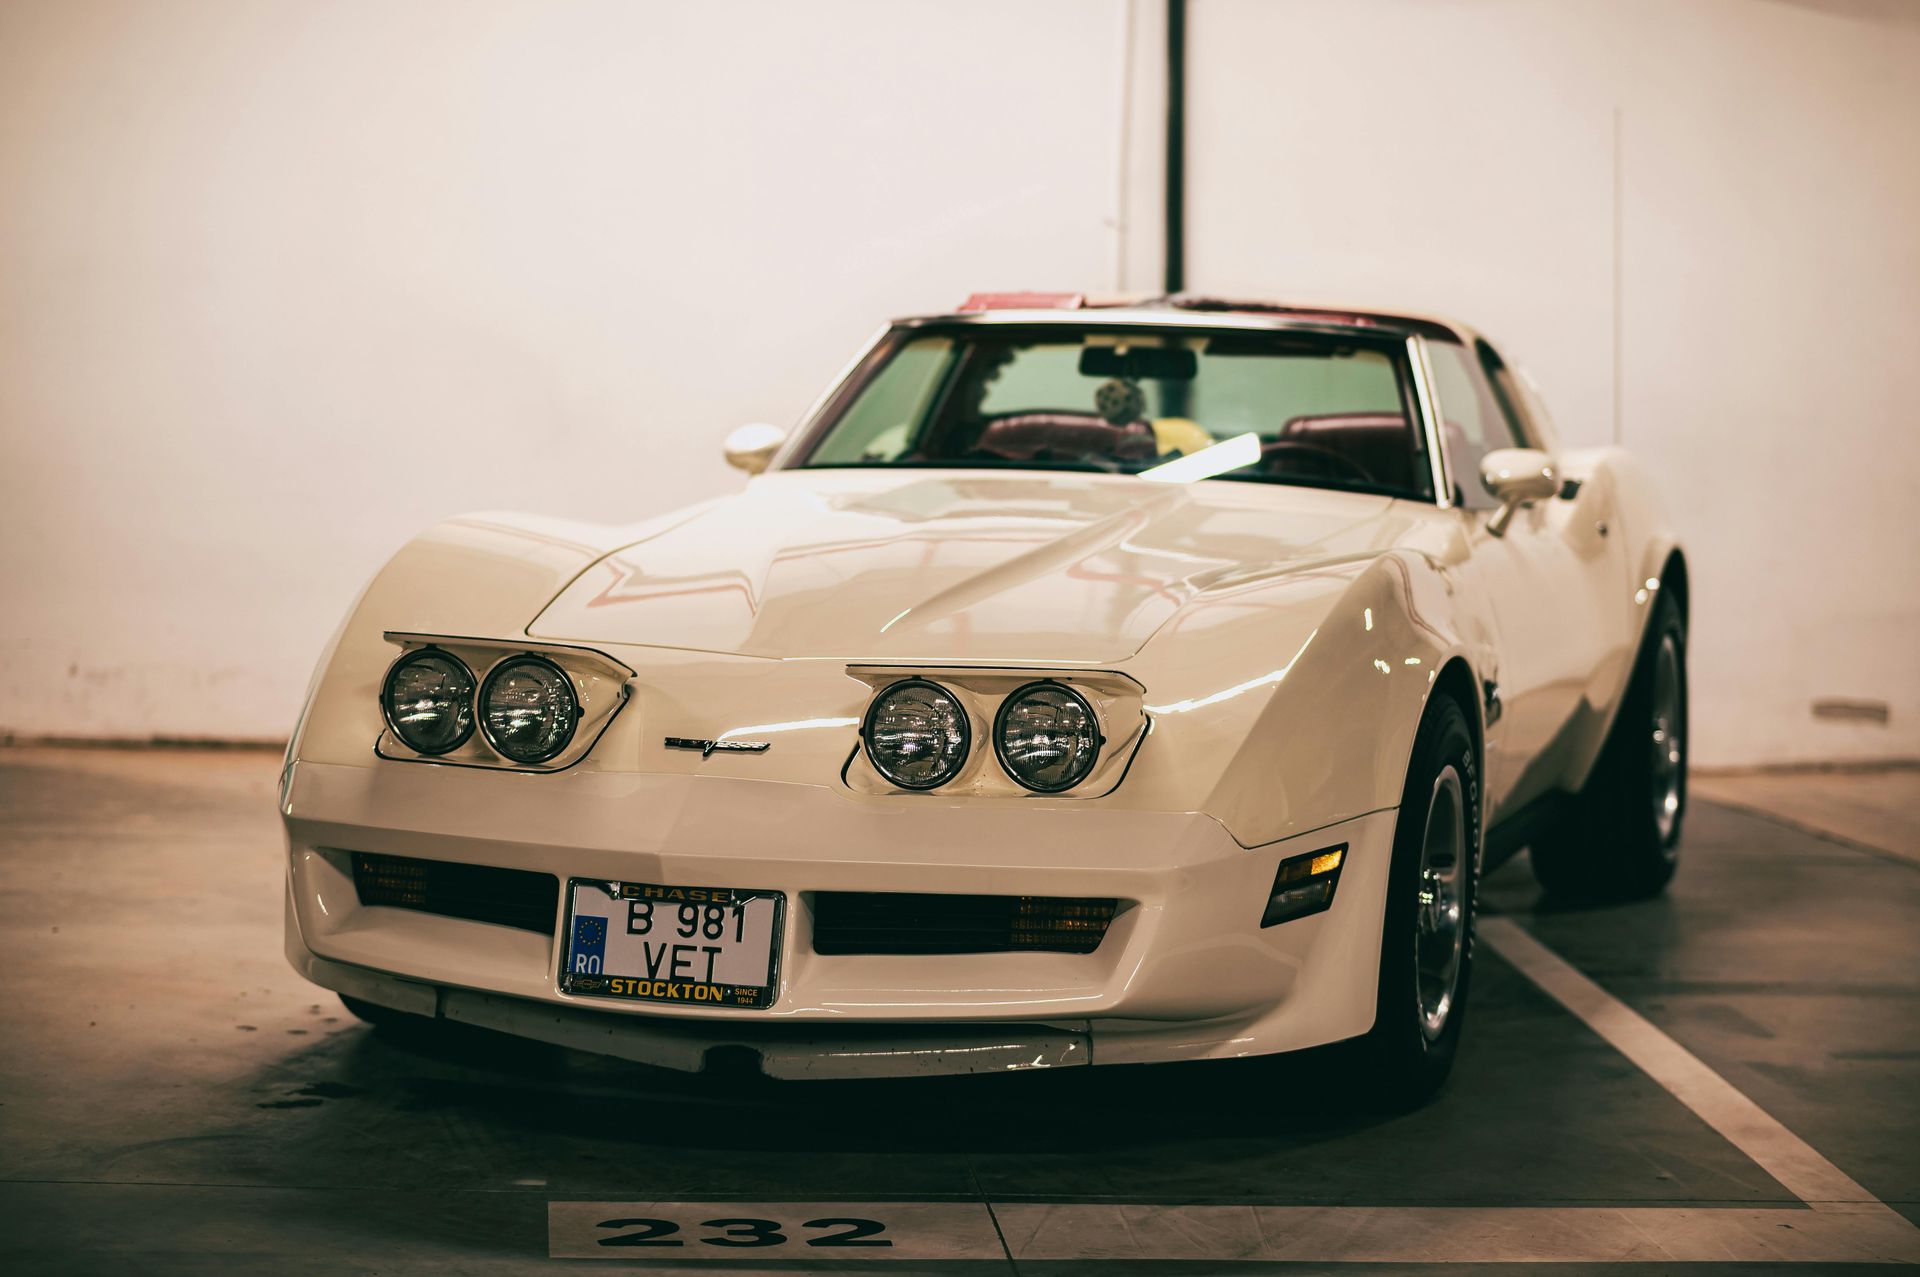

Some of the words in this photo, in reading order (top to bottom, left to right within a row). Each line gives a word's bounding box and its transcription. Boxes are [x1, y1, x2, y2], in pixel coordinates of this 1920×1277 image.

[624, 885, 729, 903] CHASE
[626, 902, 654, 935] B
[676, 905, 745, 943] 981
[575, 953, 601, 974] RO
[643, 941, 722, 983] VET
[611, 979, 723, 1001] STOCKTON
[734, 988, 758, 997] SINCE
[737, 997, 753, 1005] 1944
[596, 1218, 893, 1247] 232
